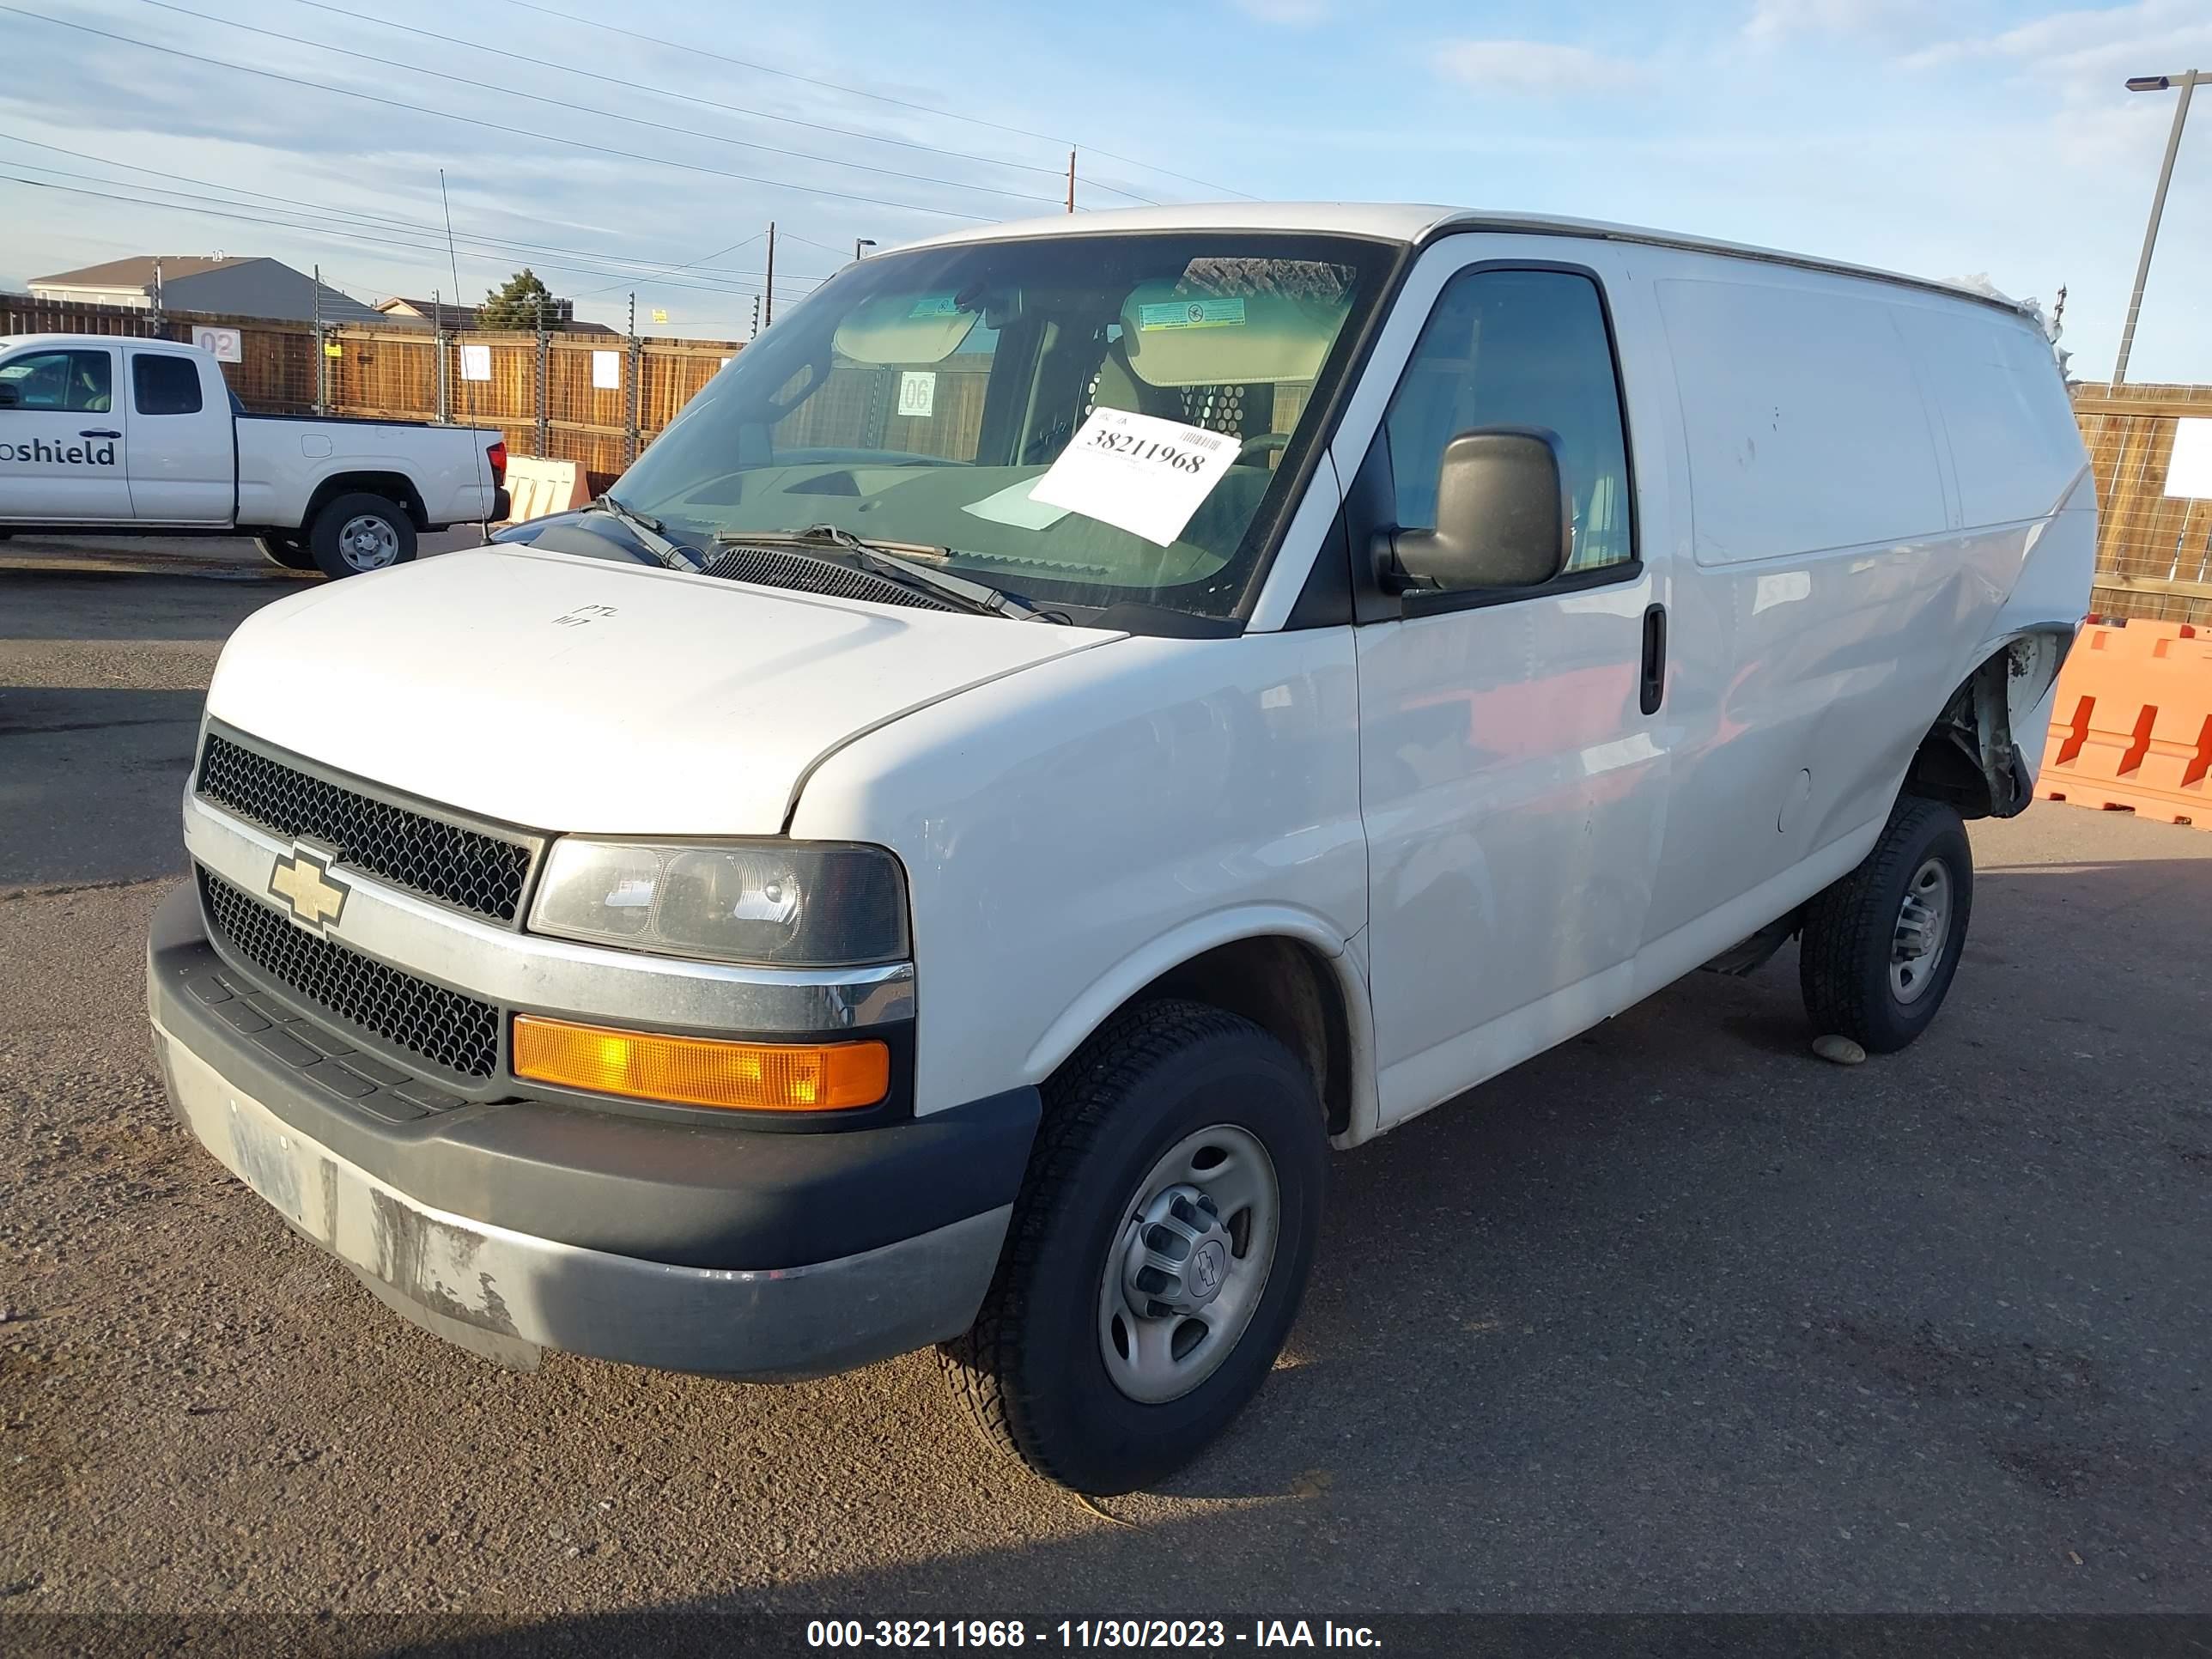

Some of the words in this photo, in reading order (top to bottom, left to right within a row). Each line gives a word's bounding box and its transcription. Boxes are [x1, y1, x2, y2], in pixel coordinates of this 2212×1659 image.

[200, 331, 234, 356] 02
[904, 378, 929, 409] 06
[0, 437, 115, 465] oshield
[1087, 429, 1206, 474] 38211968
